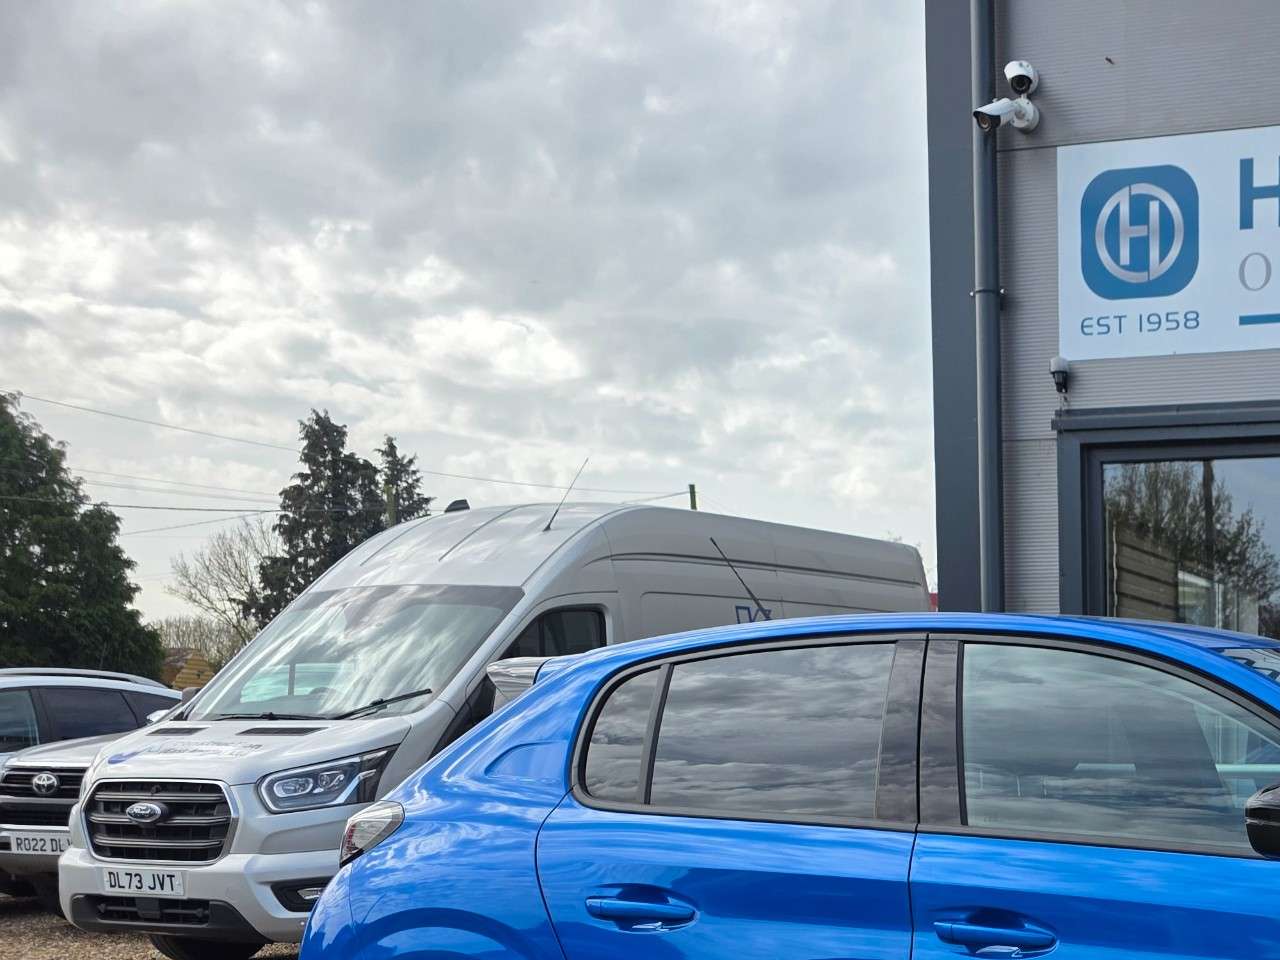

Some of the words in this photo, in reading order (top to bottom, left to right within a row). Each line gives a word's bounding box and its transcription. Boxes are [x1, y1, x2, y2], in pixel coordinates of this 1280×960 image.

[1080, 315, 1128, 336] EST
[1139, 310, 1200, 334] 1958
[50, 838, 73, 852] DL
[107, 871, 144, 890] DL73
[147, 873, 176, 892] JVT
